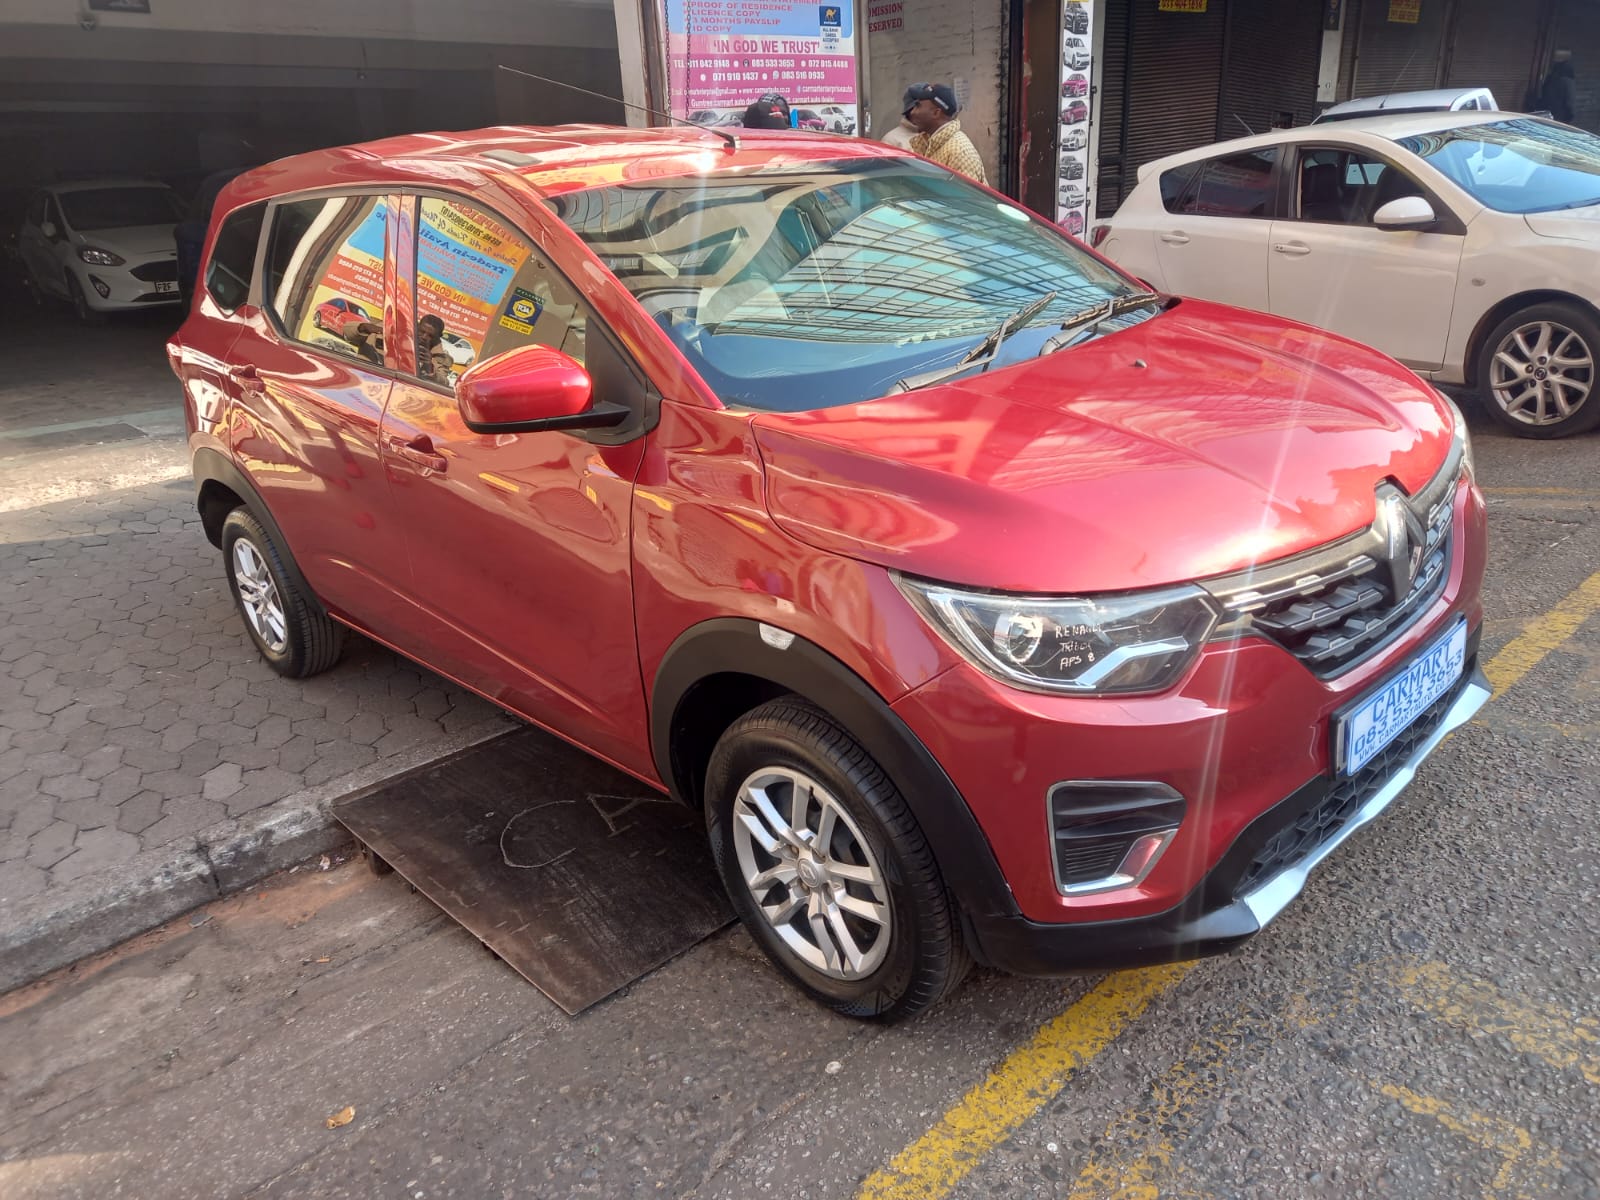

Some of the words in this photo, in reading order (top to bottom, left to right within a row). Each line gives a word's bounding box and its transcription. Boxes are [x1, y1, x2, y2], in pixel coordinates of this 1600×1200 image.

[741, 3, 793, 11] RESIDENCE
[869, 17, 902, 32] ESERVED
[734, 40, 758, 54] GOD
[761, 41, 779, 53] WE
[781, 41, 820, 54] TRUST'
[712, 72, 726, 81] 071
[742, 71, 759, 81] 1437
[1372, 638, 1453, 722] CARMART
[1354, 714, 1389, 755] 083
[1392, 684, 1424, 722] 533
[1427, 648, 1463, 692] 3653
